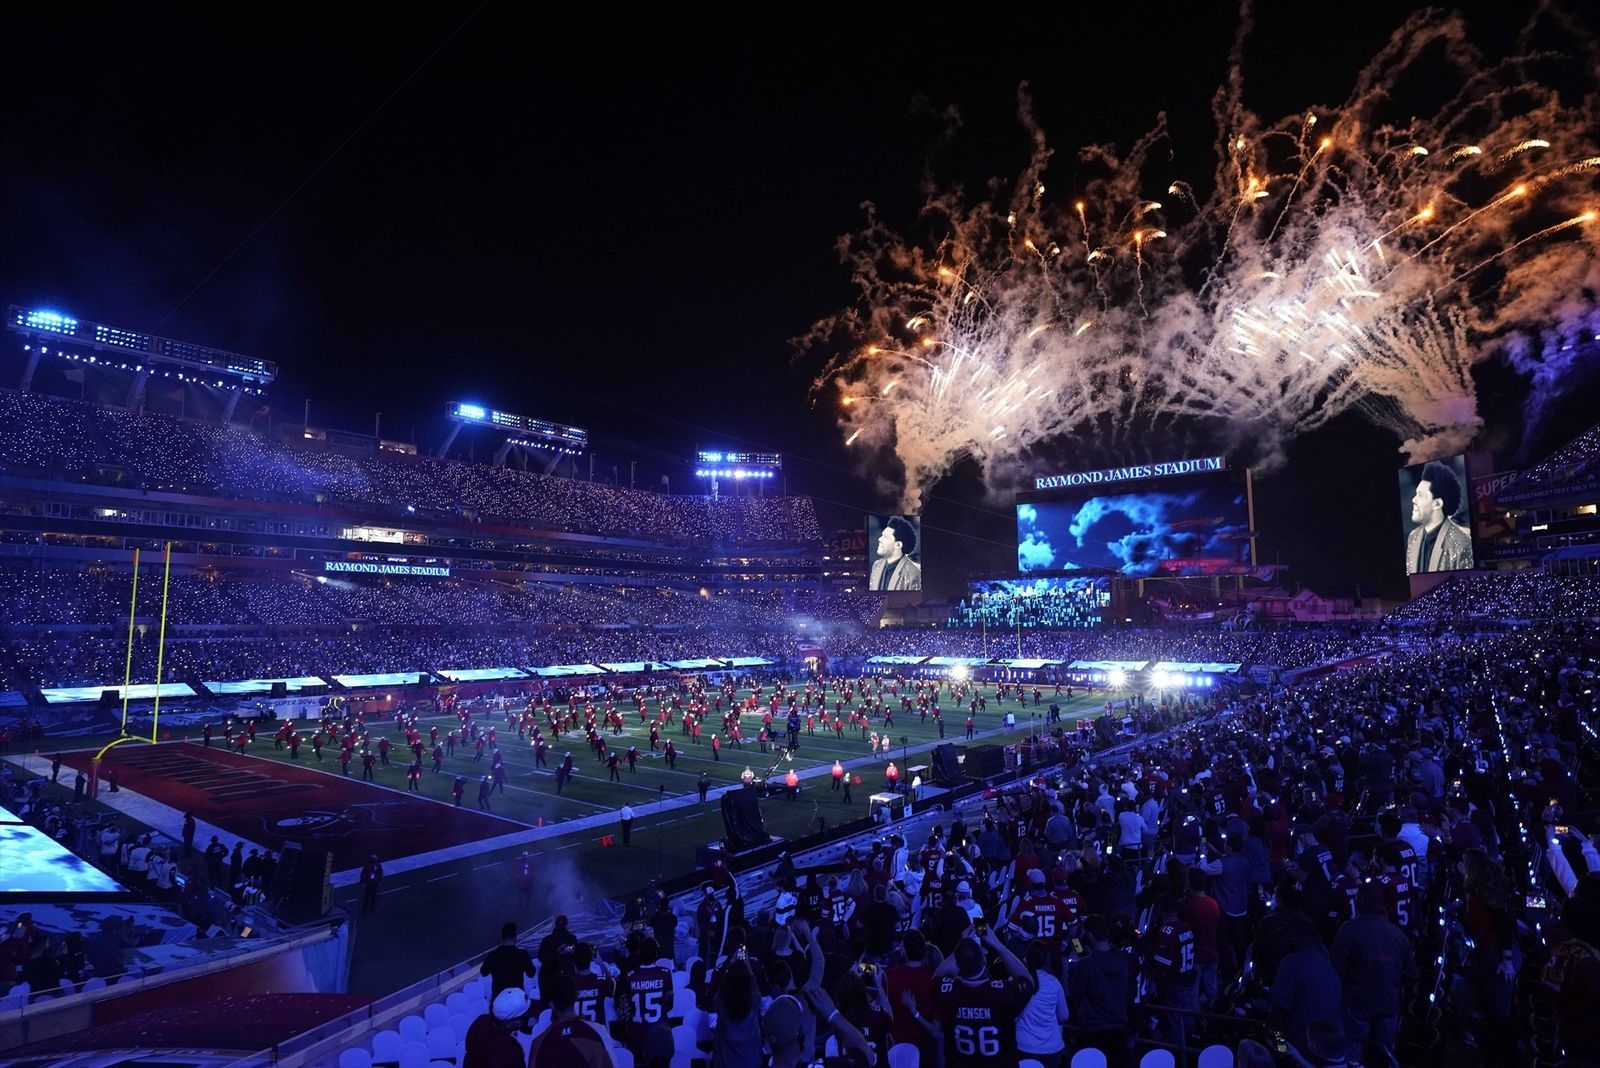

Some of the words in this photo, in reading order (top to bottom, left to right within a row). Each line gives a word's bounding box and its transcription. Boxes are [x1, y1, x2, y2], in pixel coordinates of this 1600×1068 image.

[1036, 471, 1103, 489] RAYMOND
[1105, 465, 1152, 482] JAMES
[1154, 457, 1221, 476] STADIUM
[1475, 472, 1518, 500] SUPER
[325, 561, 378, 573] RAYMOND
[379, 564, 410, 575] JAMES
[411, 566, 450, 577] STADIUM
[1093, 840, 1103, 856] 2
[928, 891, 943, 909] 12
[1037, 915, 1056, 938] 15
[1180, 942, 1195, 974] 15
[630, 979, 664, 991] MAHOMES
[631, 991, 663, 1024] 15
[955, 1006, 992, 1020] JENSEN
[954, 1024, 1000, 1057] 66
